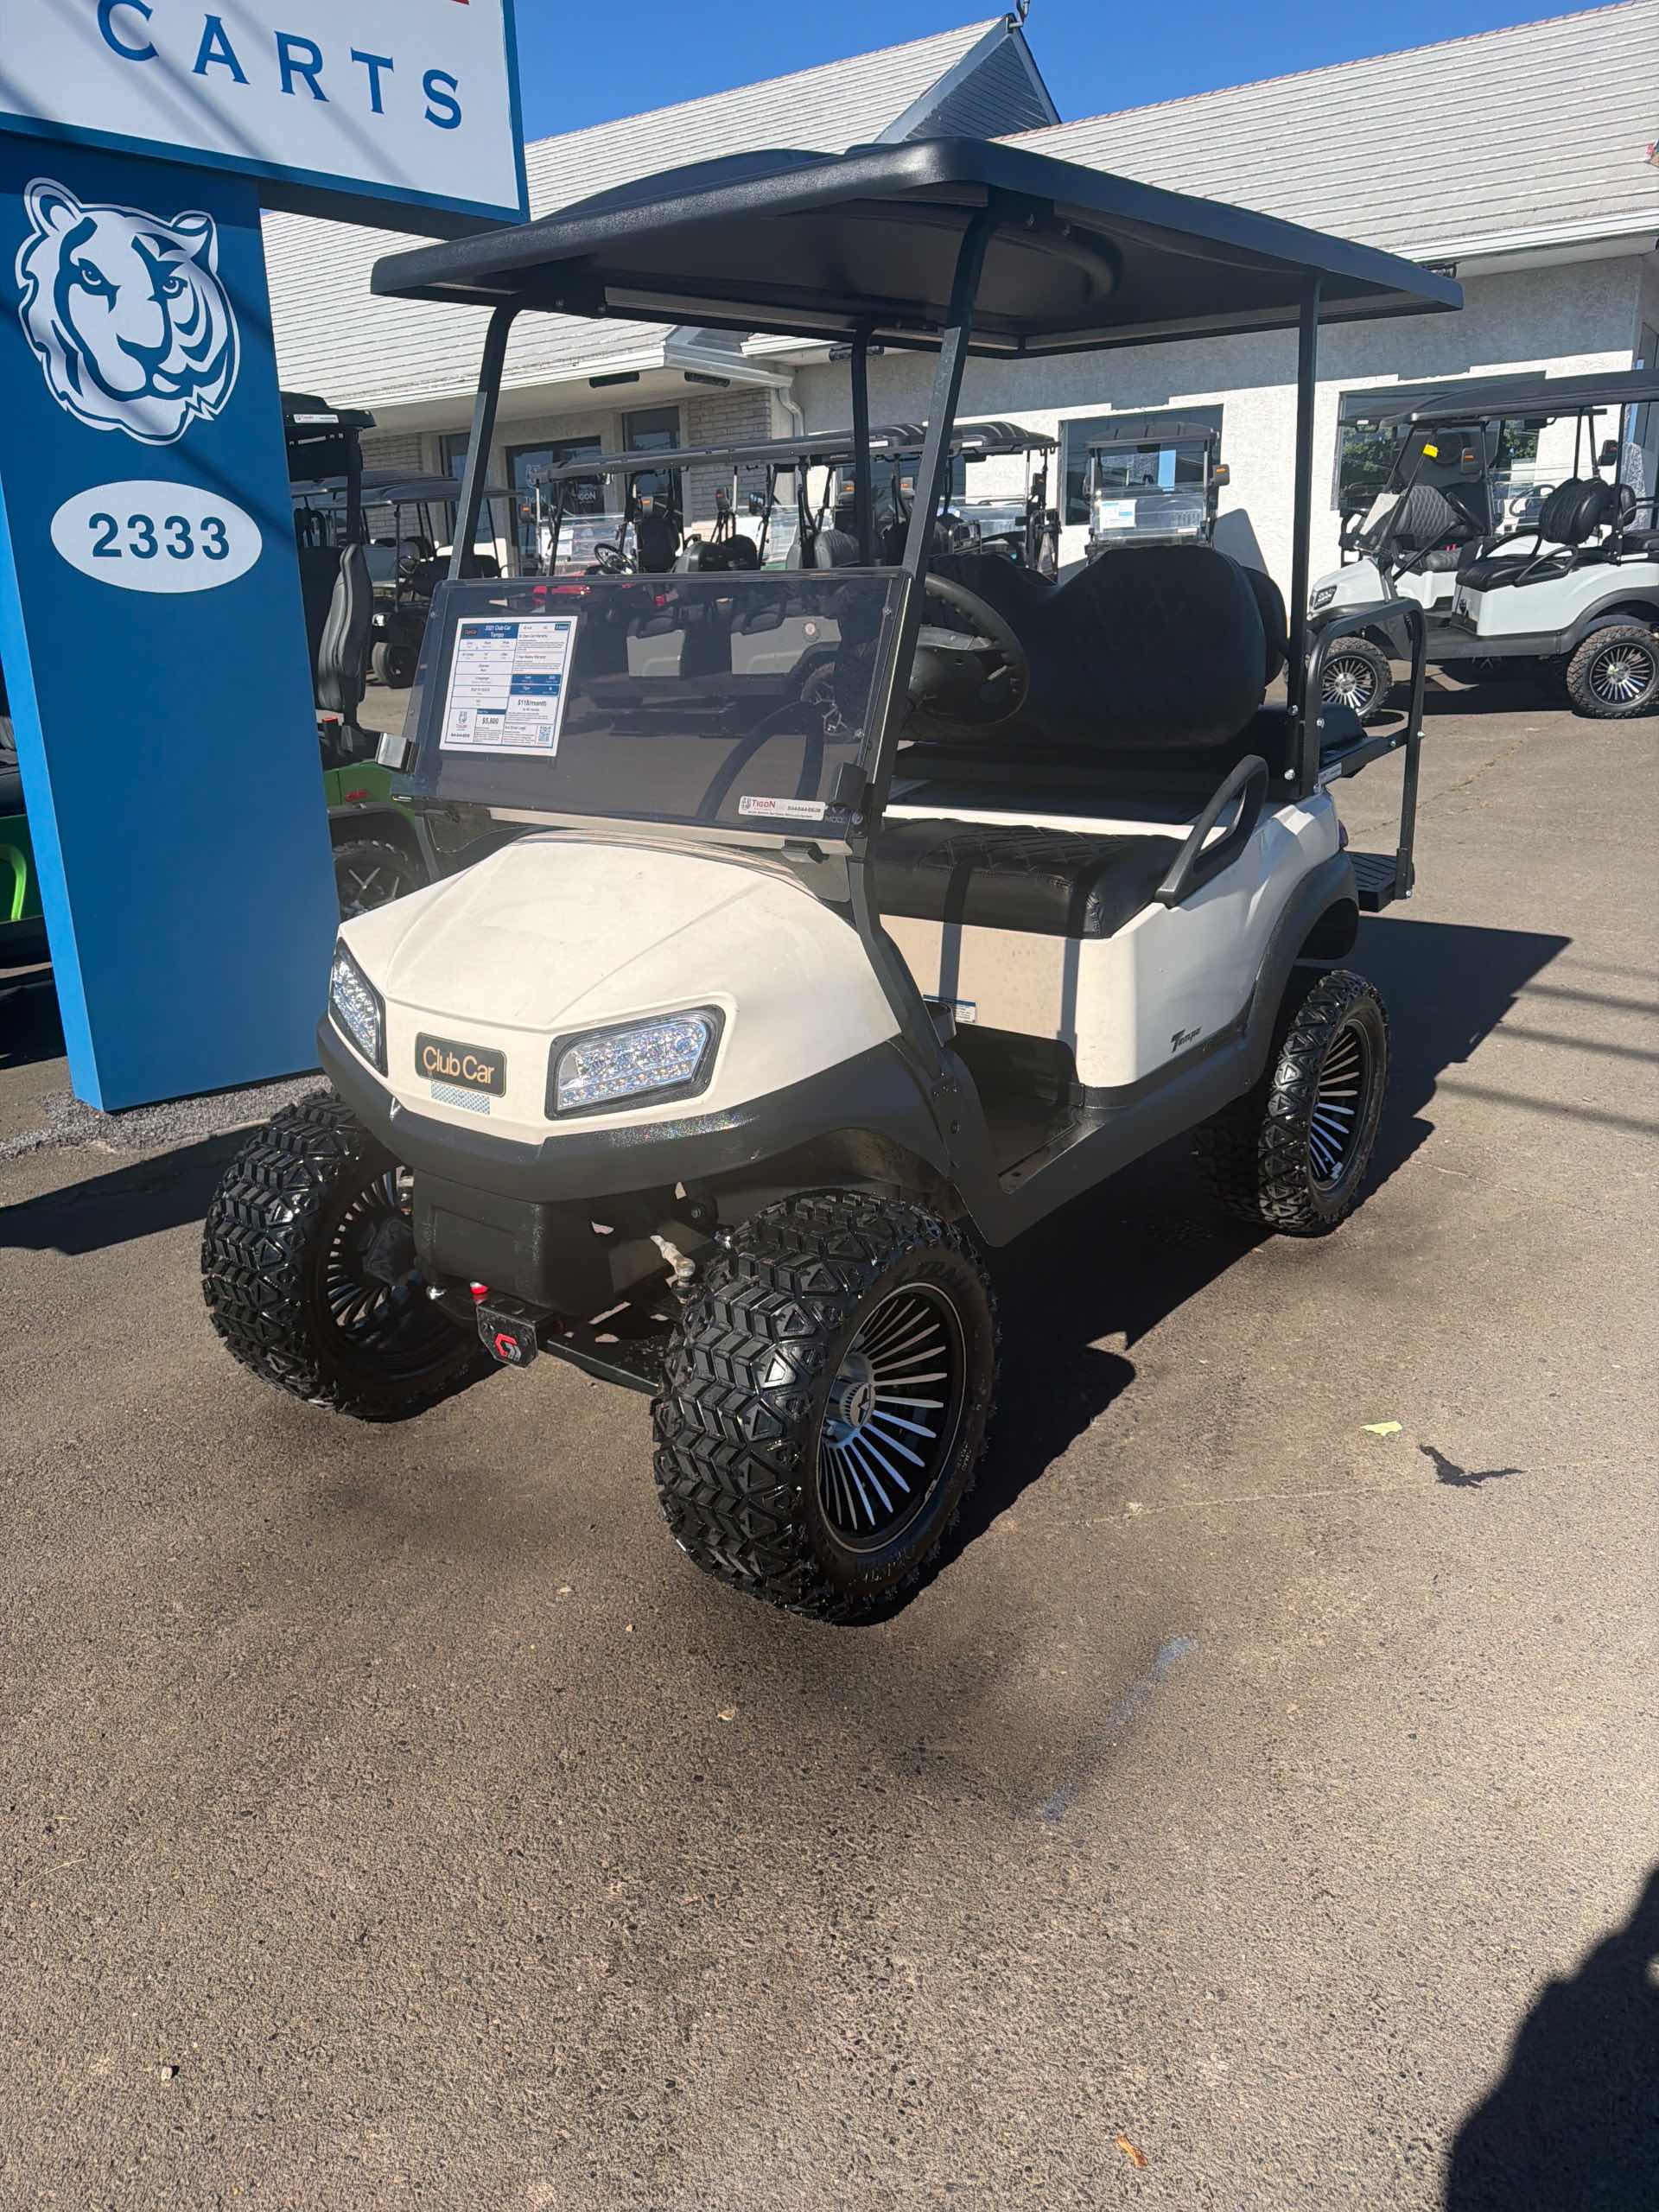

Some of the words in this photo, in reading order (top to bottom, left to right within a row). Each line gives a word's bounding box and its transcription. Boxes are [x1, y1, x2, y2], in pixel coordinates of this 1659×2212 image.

[96, 0, 463, 130] CARTS
[525, 495, 546, 504] TIGN
[88, 512, 231, 561] 2333
[423, 1046, 461, 1077] Club
[462, 1055, 495, 1084] Car
